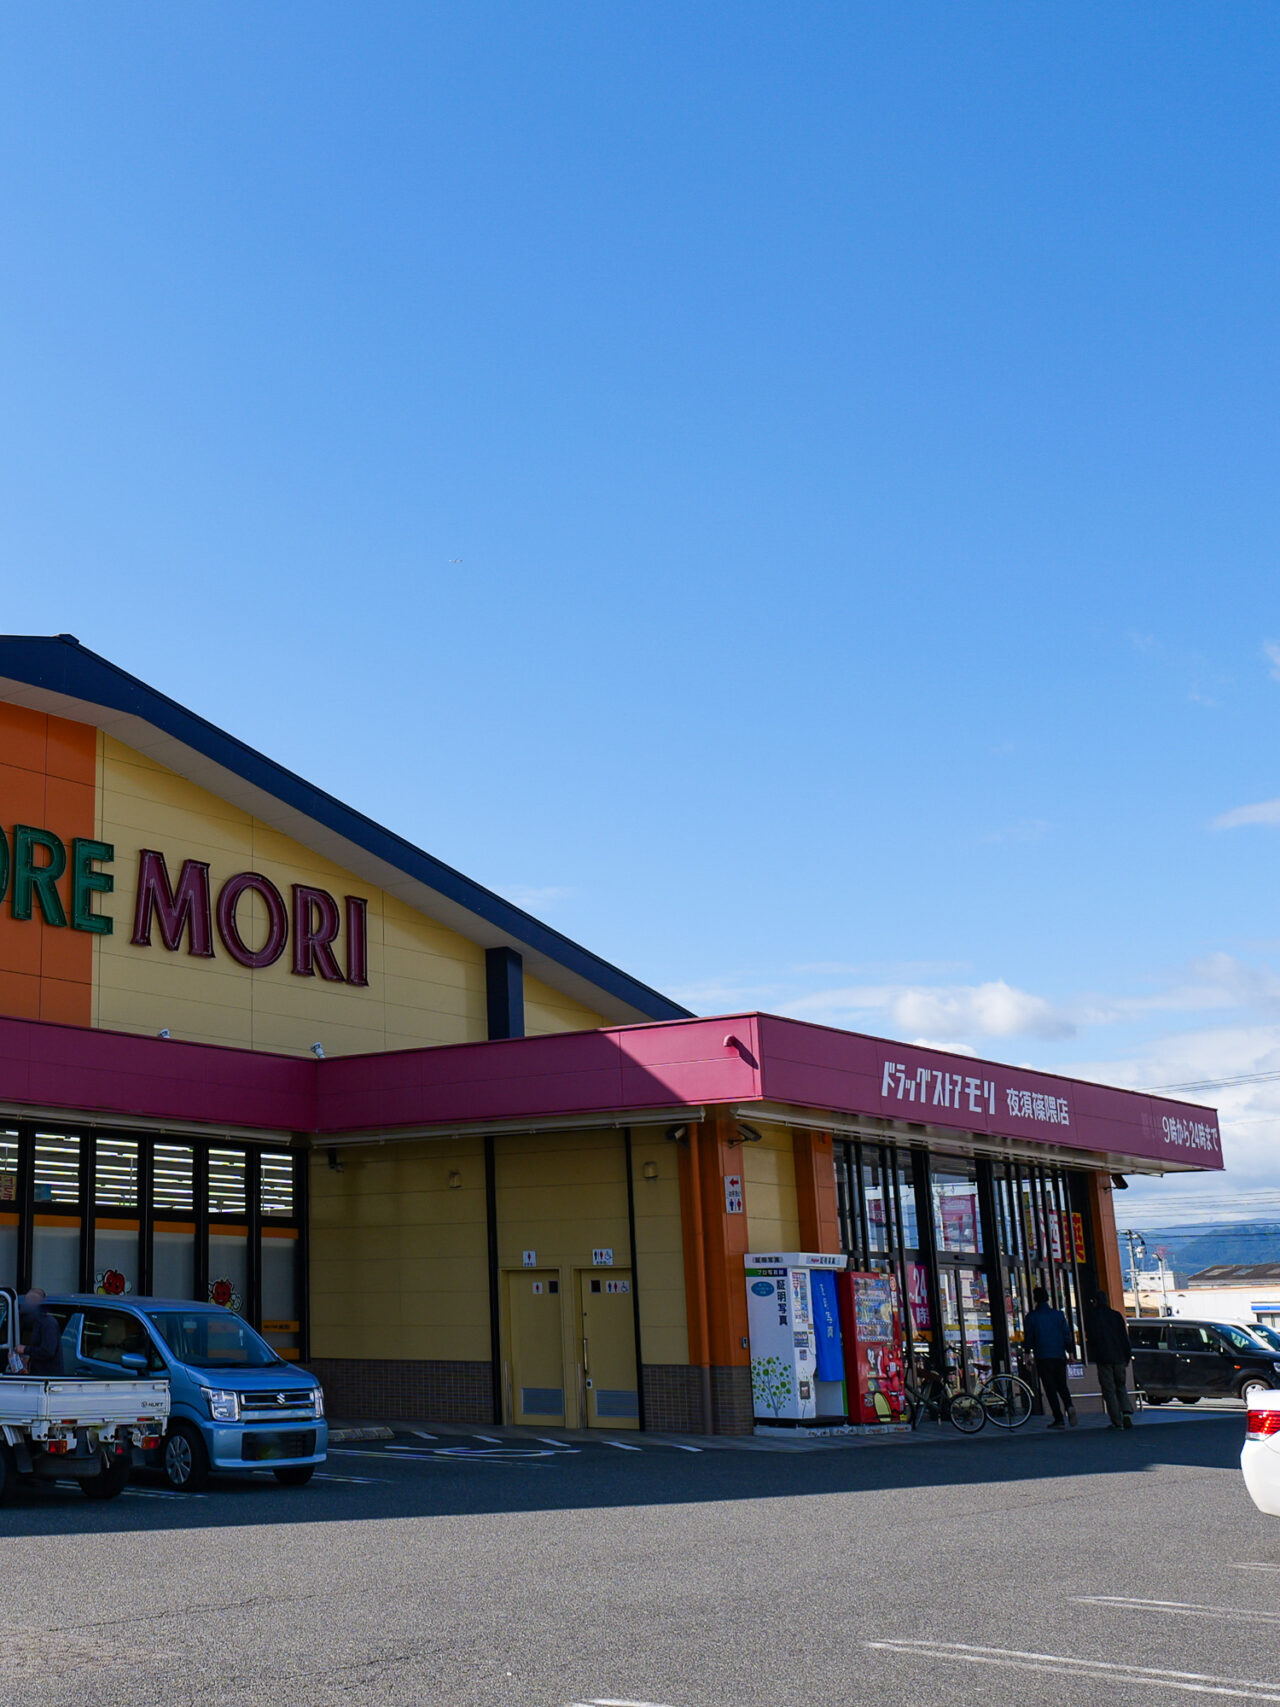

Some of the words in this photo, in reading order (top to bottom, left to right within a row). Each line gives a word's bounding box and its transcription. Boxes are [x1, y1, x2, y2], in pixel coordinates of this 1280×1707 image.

[130, 848, 369, 986] MORI
[881, 1061, 995, 1115] ドラッグストアモリ
[1162, 1116, 1218, 1151] 9時から24時まで
[776, 1279, 788, 1326] 証明写真
[913, 1267, 928, 1304] 24
